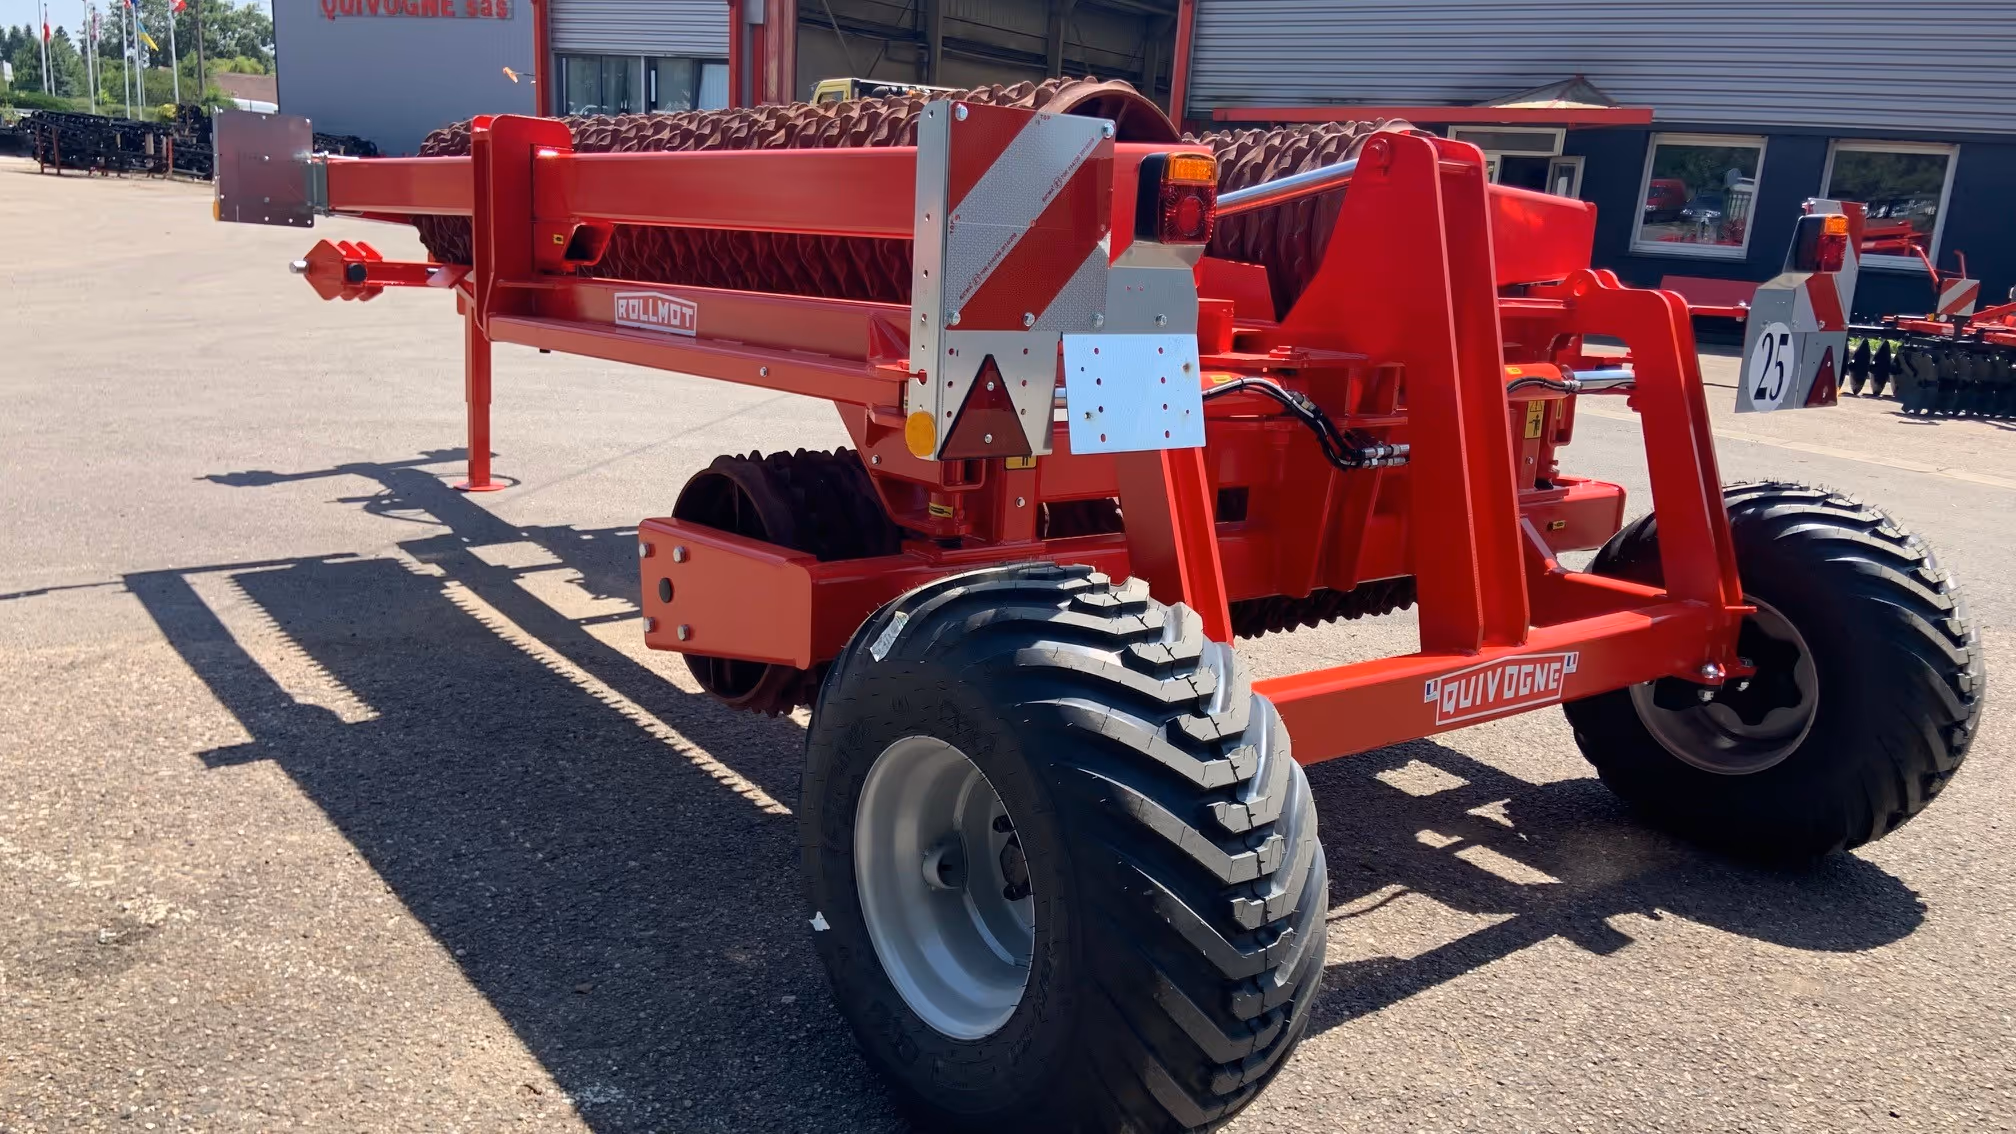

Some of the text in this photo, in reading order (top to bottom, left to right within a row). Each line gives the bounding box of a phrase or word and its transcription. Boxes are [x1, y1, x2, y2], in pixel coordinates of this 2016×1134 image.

[321, 0, 508, 21] QUIVOGNE sas
[618, 298, 694, 328] ROLLMOT
[1753, 332, 1790, 401] 25
[1442, 662, 1561, 714] QUIVOGNE
